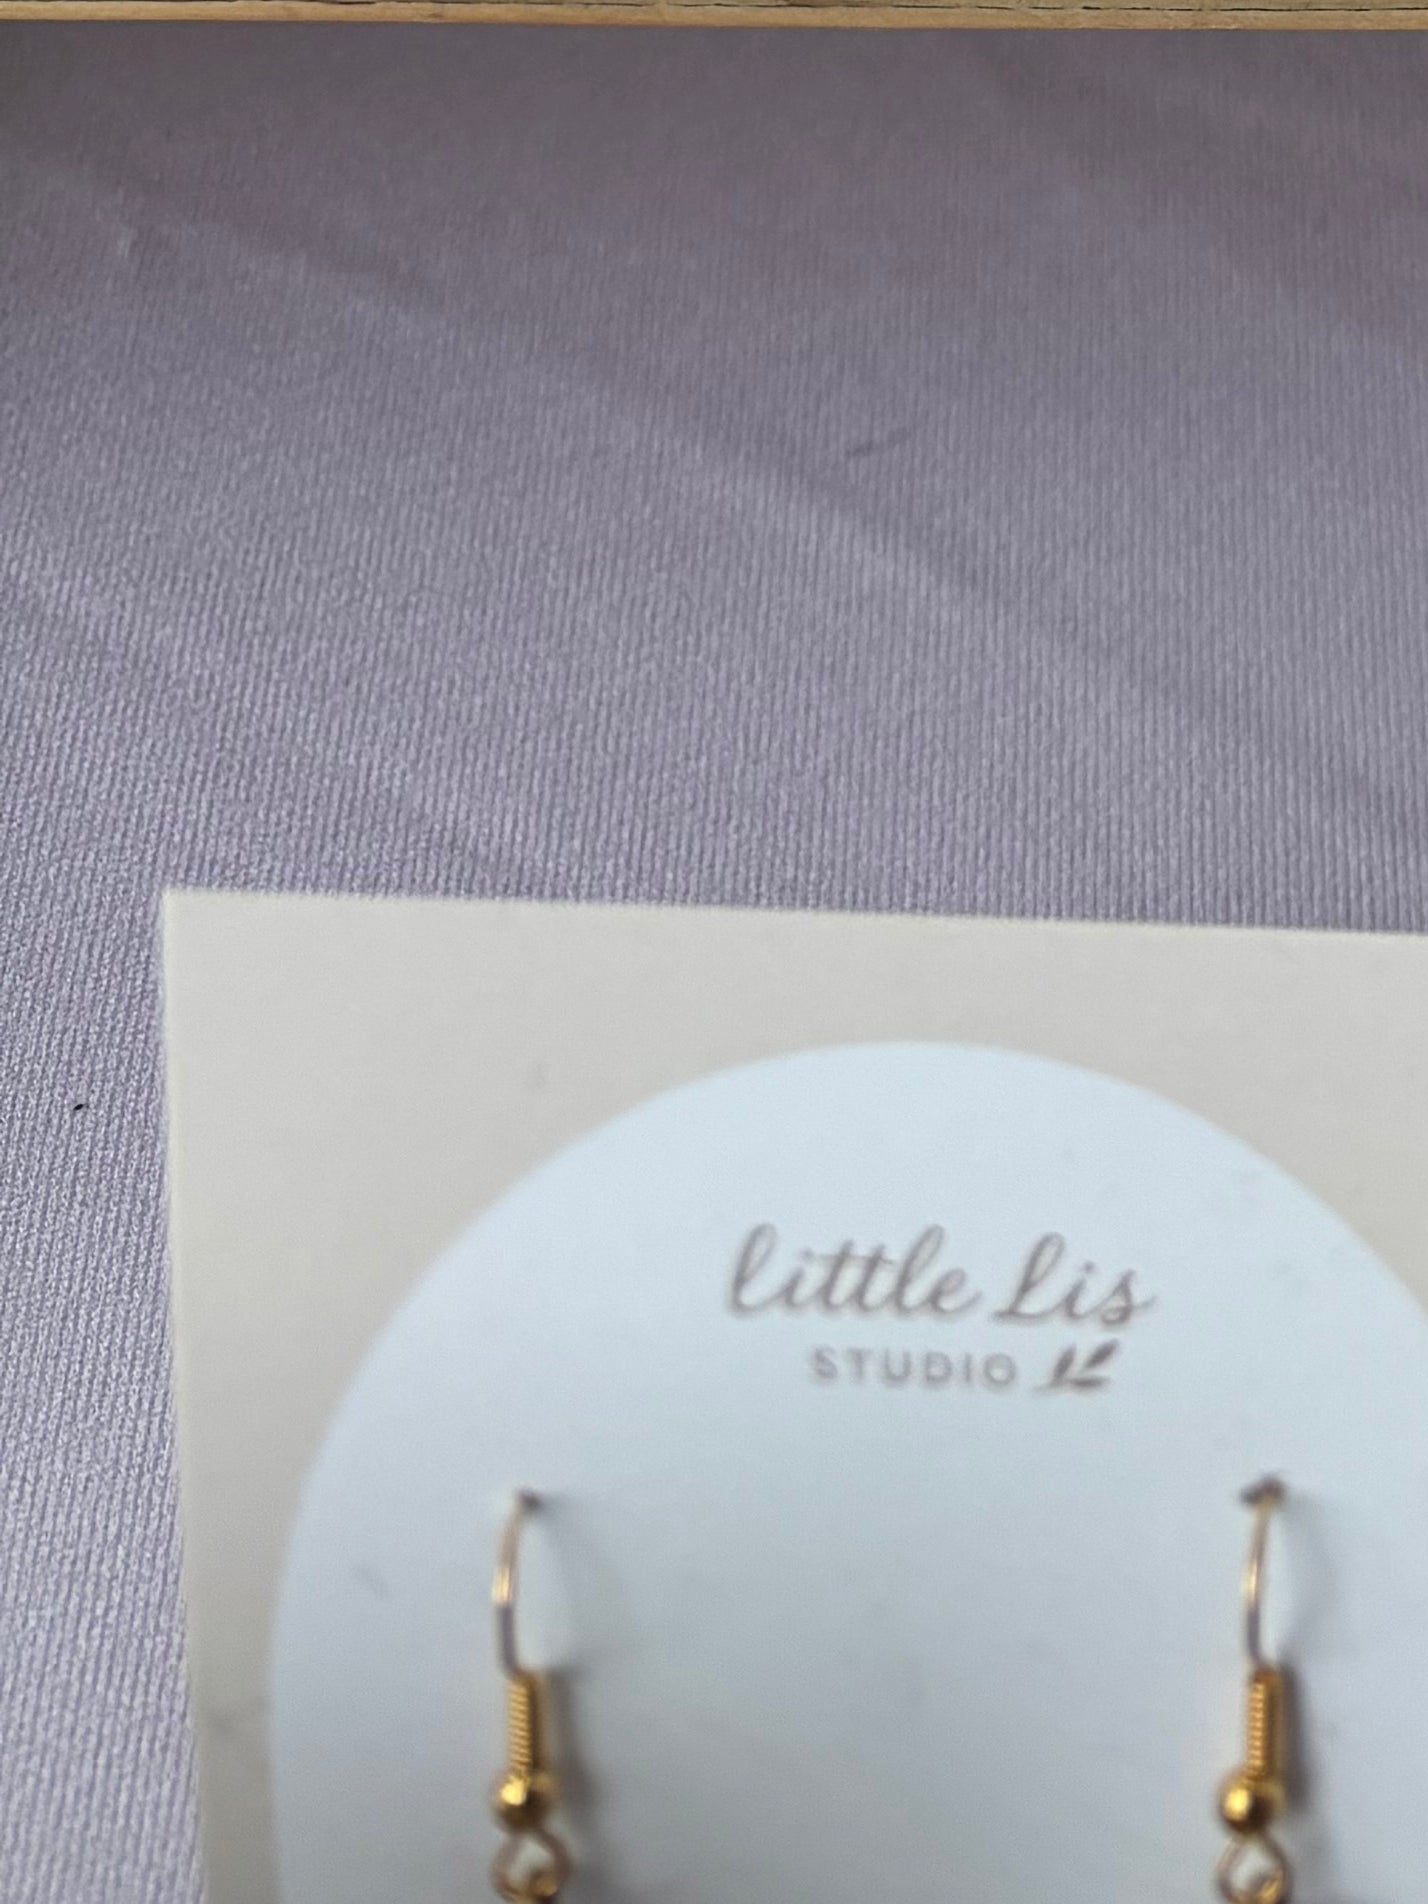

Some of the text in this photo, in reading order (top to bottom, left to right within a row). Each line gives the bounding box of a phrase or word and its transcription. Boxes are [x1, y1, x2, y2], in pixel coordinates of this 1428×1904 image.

[727, 1223, 1155, 1332] little Lis
[809, 1345, 1019, 1390] STUDIO
